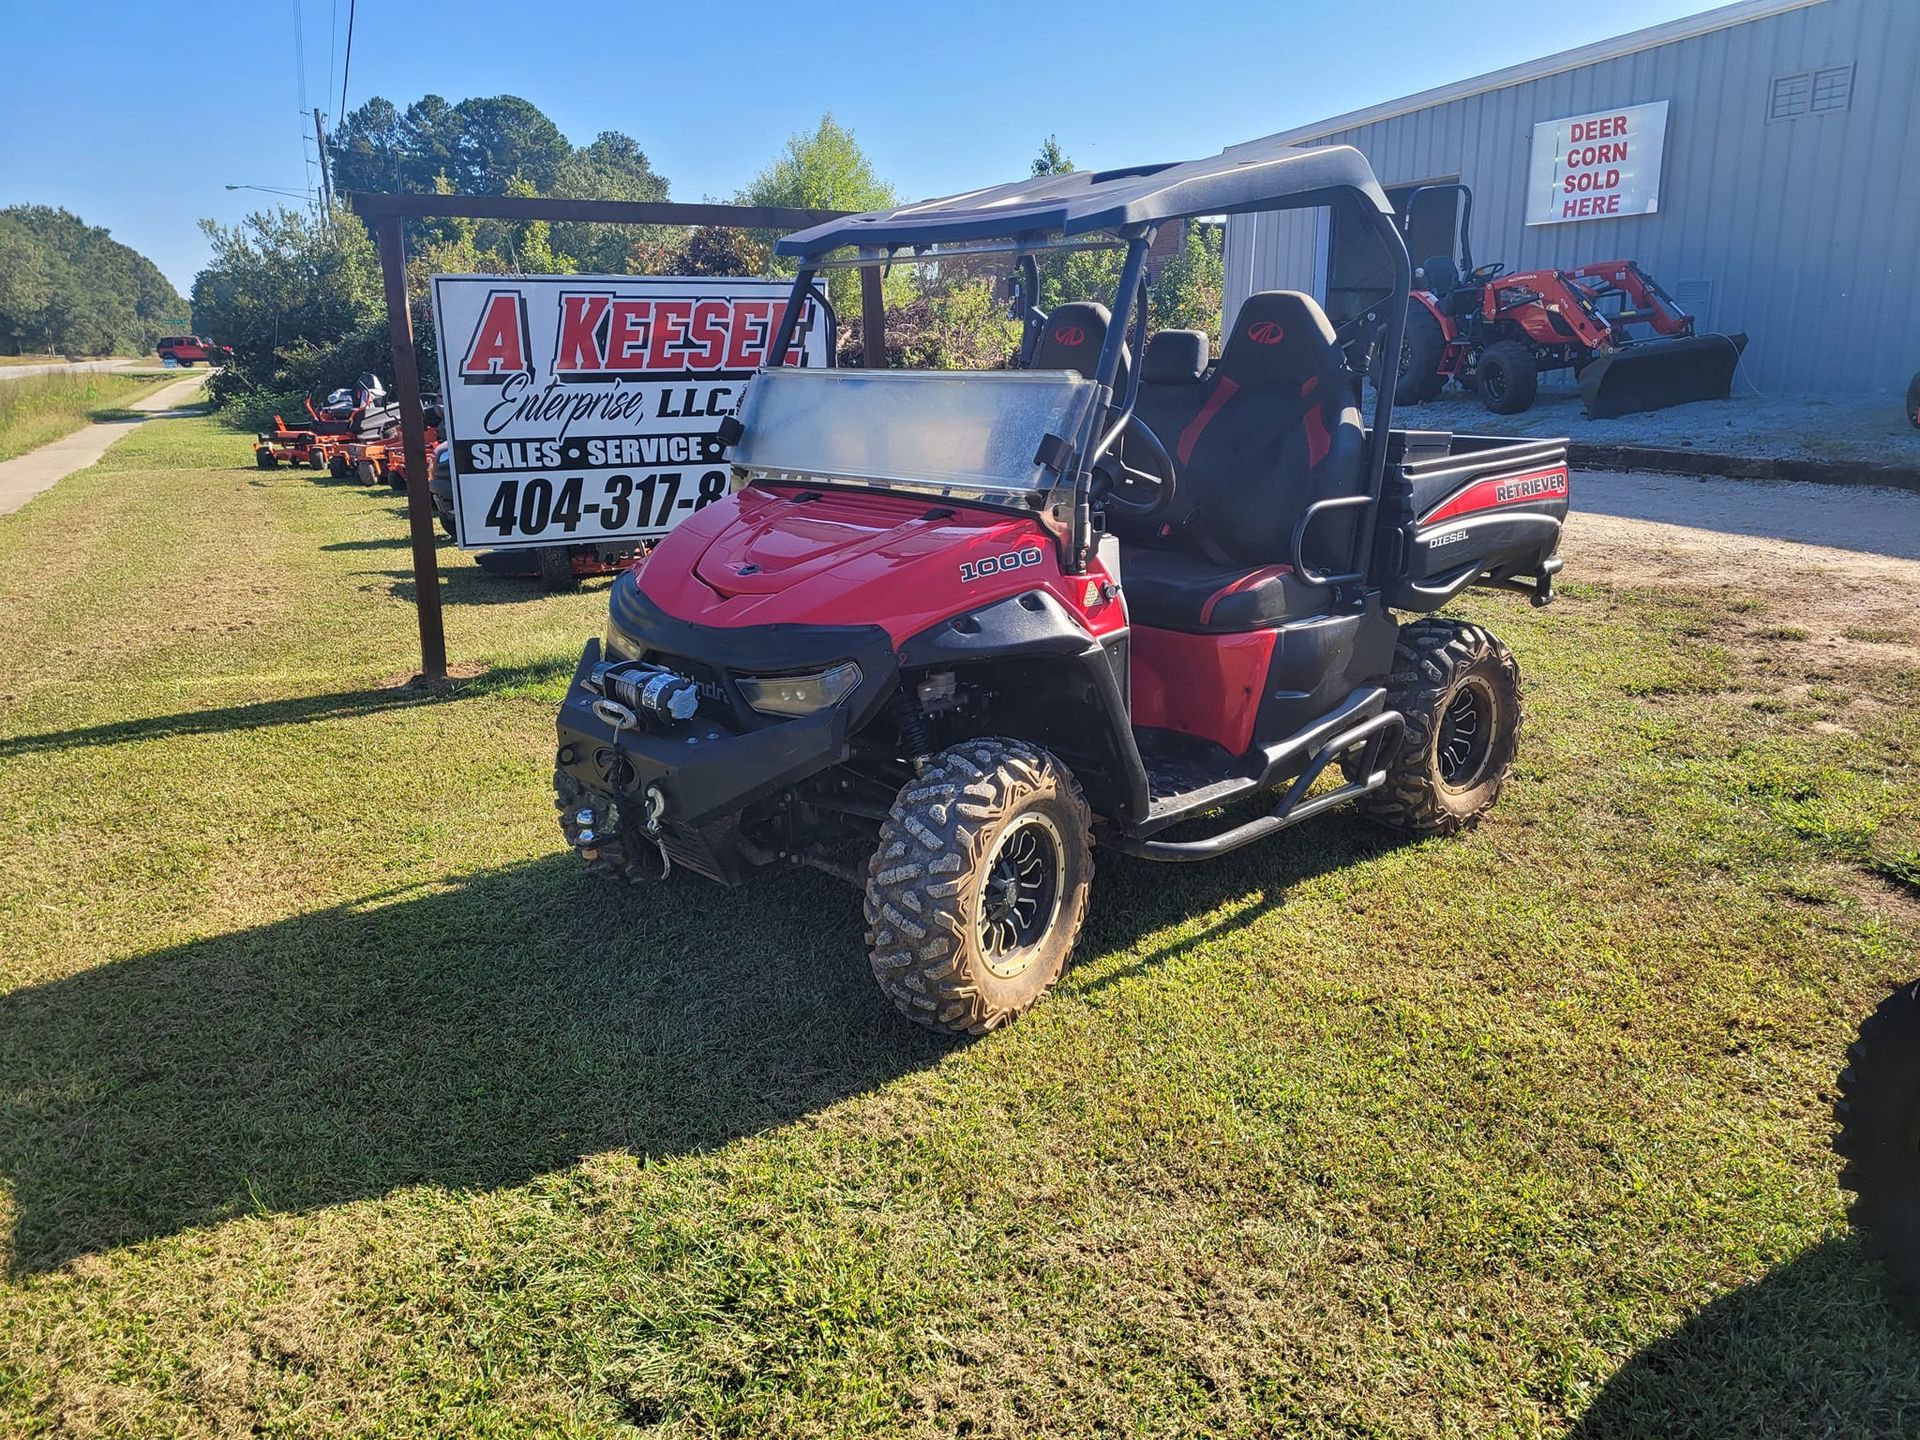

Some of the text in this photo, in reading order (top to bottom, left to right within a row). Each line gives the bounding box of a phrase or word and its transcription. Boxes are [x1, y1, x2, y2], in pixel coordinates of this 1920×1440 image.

[1570, 116, 1628, 143] DEER
[1567, 142, 1628, 170] CORN
[1563, 169, 1620, 194] SOLD
[1562, 194, 1621, 218] HERE
[463, 293, 529, 377] A
[484, 371, 645, 440] Enterprise,
[471, 436, 703, 469] SALES SERVICE
[1496, 474, 1566, 502] RETRIEVER
[485, 470, 731, 536] 404-317-8
[1429, 530, 1469, 549] DIESEL
[960, 546, 1043, 583] 1000
